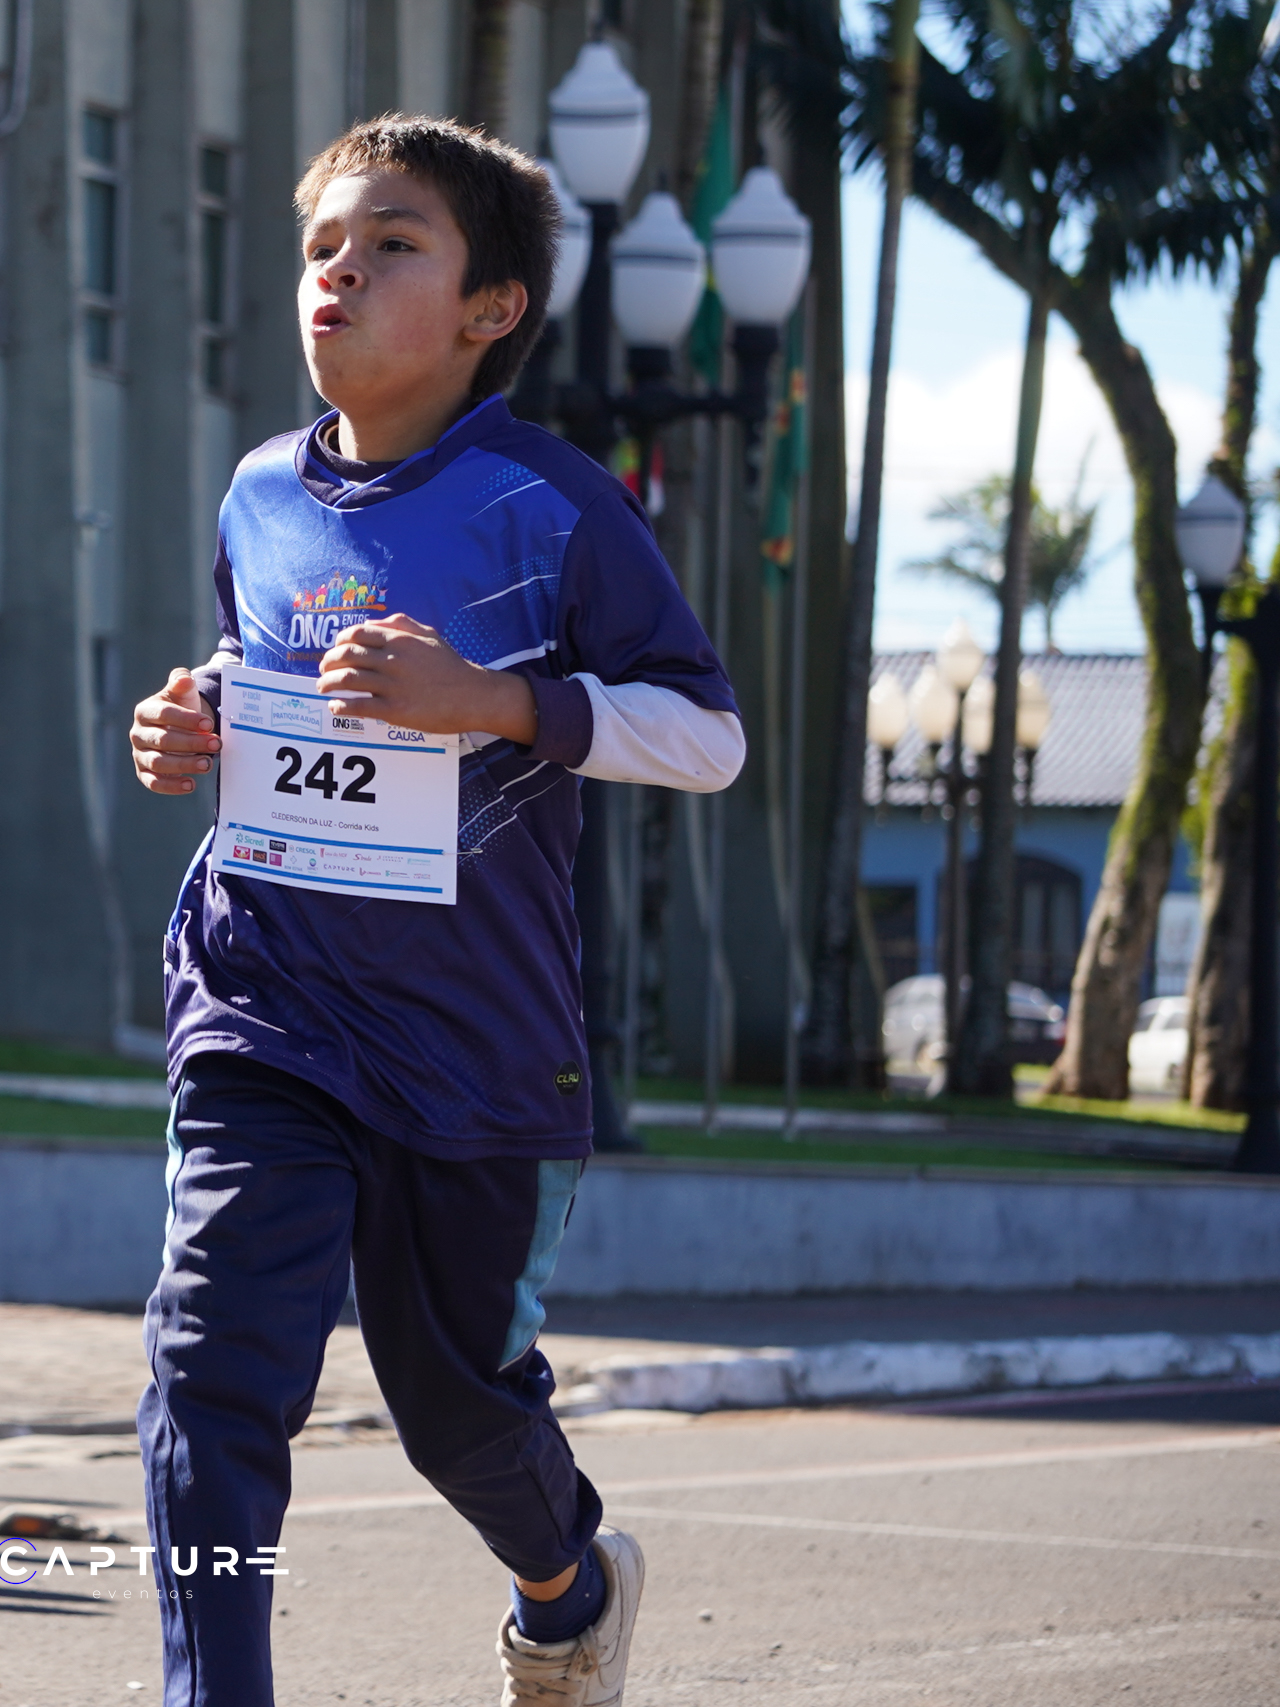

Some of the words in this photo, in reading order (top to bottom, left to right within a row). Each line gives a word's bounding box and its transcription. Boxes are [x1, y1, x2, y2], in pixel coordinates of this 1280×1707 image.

[287, 613, 339, 649] ONG
[272, 712, 300, 721] PRATIQUE
[300, 714, 320, 726] AJUDA
[332, 717, 350, 729] ONG
[387, 730, 426, 742] CAUSA
[274, 746, 376, 804] 242
[271, 811, 308, 824] CLEDERSON
[308, 817, 319, 826] DA
[319, 819, 333, 828] LUZ
[338, 821, 363, 831] Corrida
[364, 824, 380, 832] Kids
[244, 835, 265, 847] Sicredi
[295, 847, 317, 855] CRESOL
